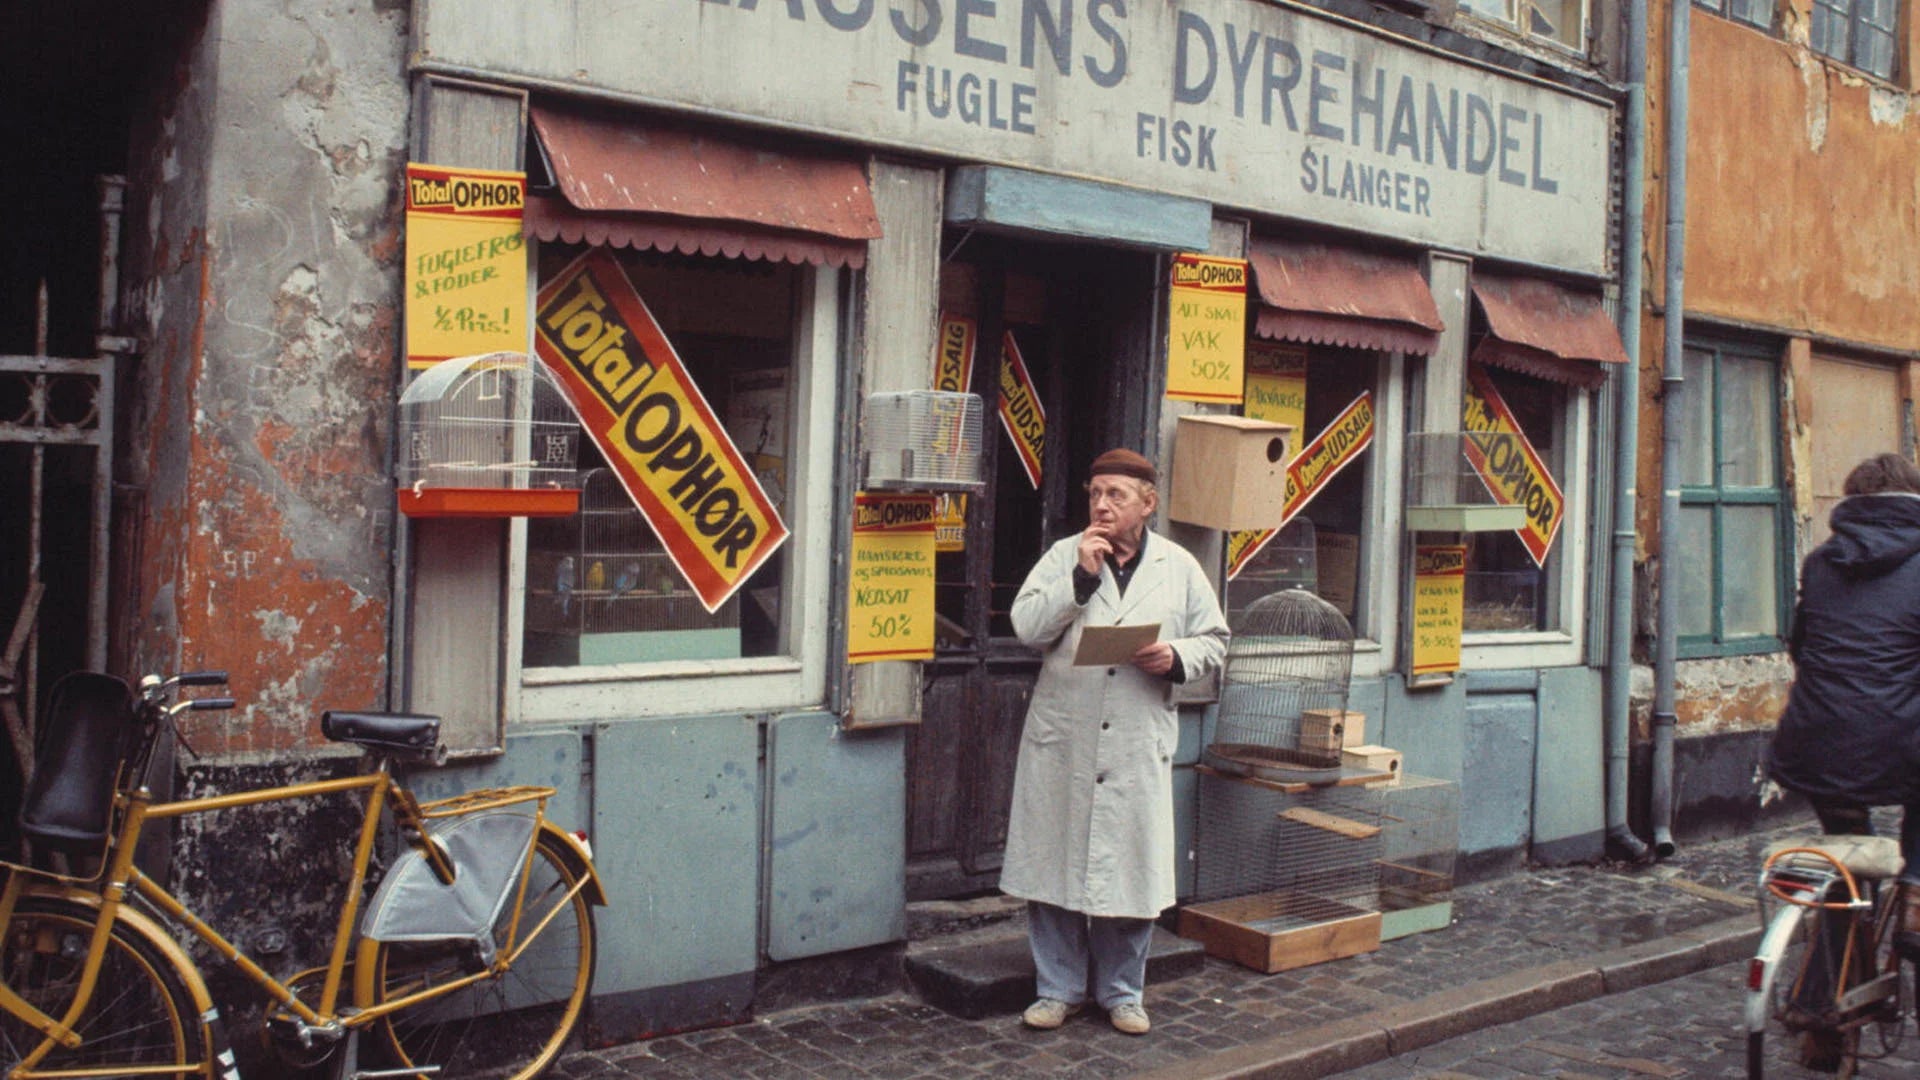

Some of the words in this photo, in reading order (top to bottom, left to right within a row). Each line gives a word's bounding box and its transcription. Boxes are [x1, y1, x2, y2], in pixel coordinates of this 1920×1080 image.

[700, 0, 1128, 88] SENS
[1174, 12, 1558, 194] DYREHANDEL
[897, 60, 1036, 135] FUGLE
[1137, 113, 1216, 172] FISK
[411, 178, 452, 205] Total
[1300, 147, 1431, 217] SLANGER
[547, 272, 656, 407] Total
[1191, 359, 1231, 382] 50%
[1327, 403, 1371, 461] UDSALG
[868, 614, 913, 638] 50%
